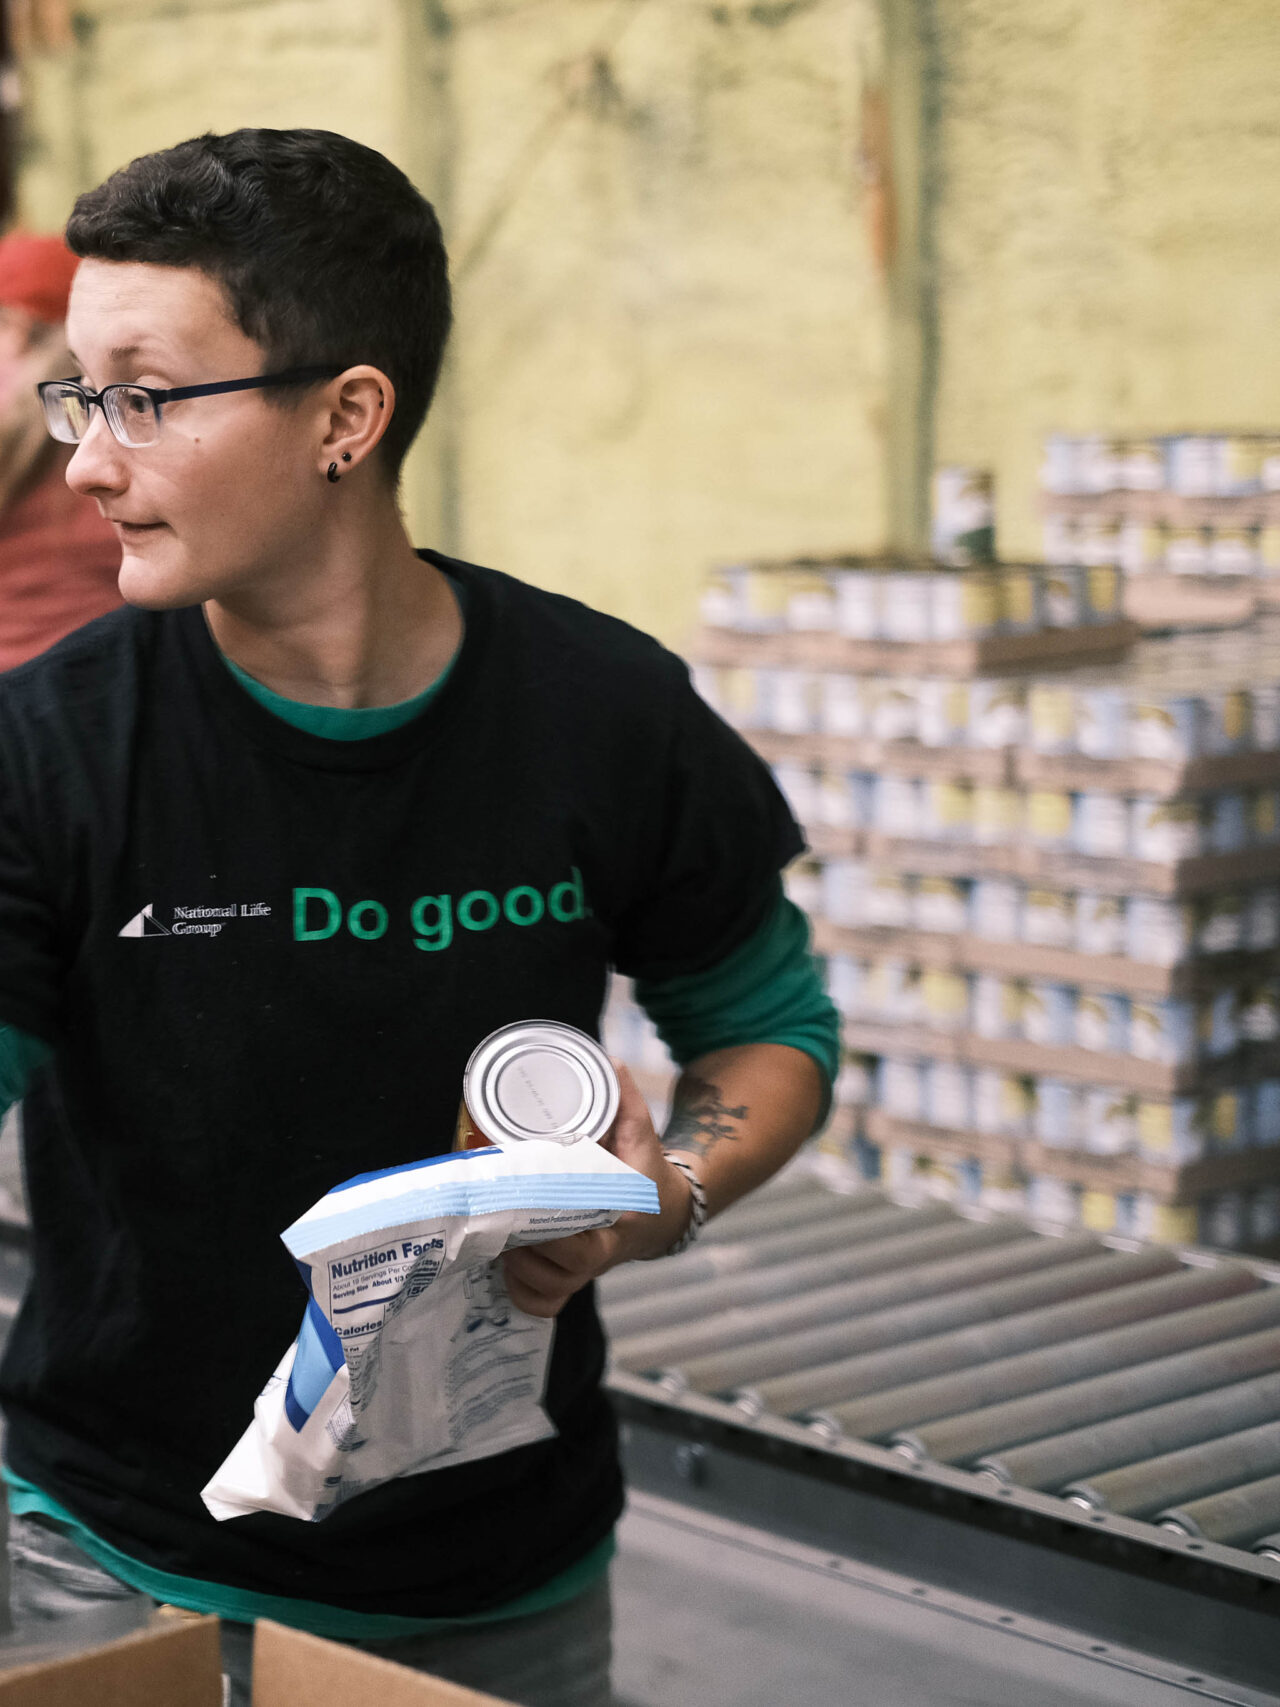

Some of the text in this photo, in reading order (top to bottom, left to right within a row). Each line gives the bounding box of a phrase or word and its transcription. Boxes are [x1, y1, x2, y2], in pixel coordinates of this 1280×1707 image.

[173, 902, 272, 920] National Life
[292, 886, 389, 942] Do
[171, 921, 223, 938] Group
[331, 1238, 444, 1280] Nutrition Facts
[332, 1289, 356, 1300] Serving
[372, 1278, 392, 1288] About
[334, 1320, 383, 1337] Calories
